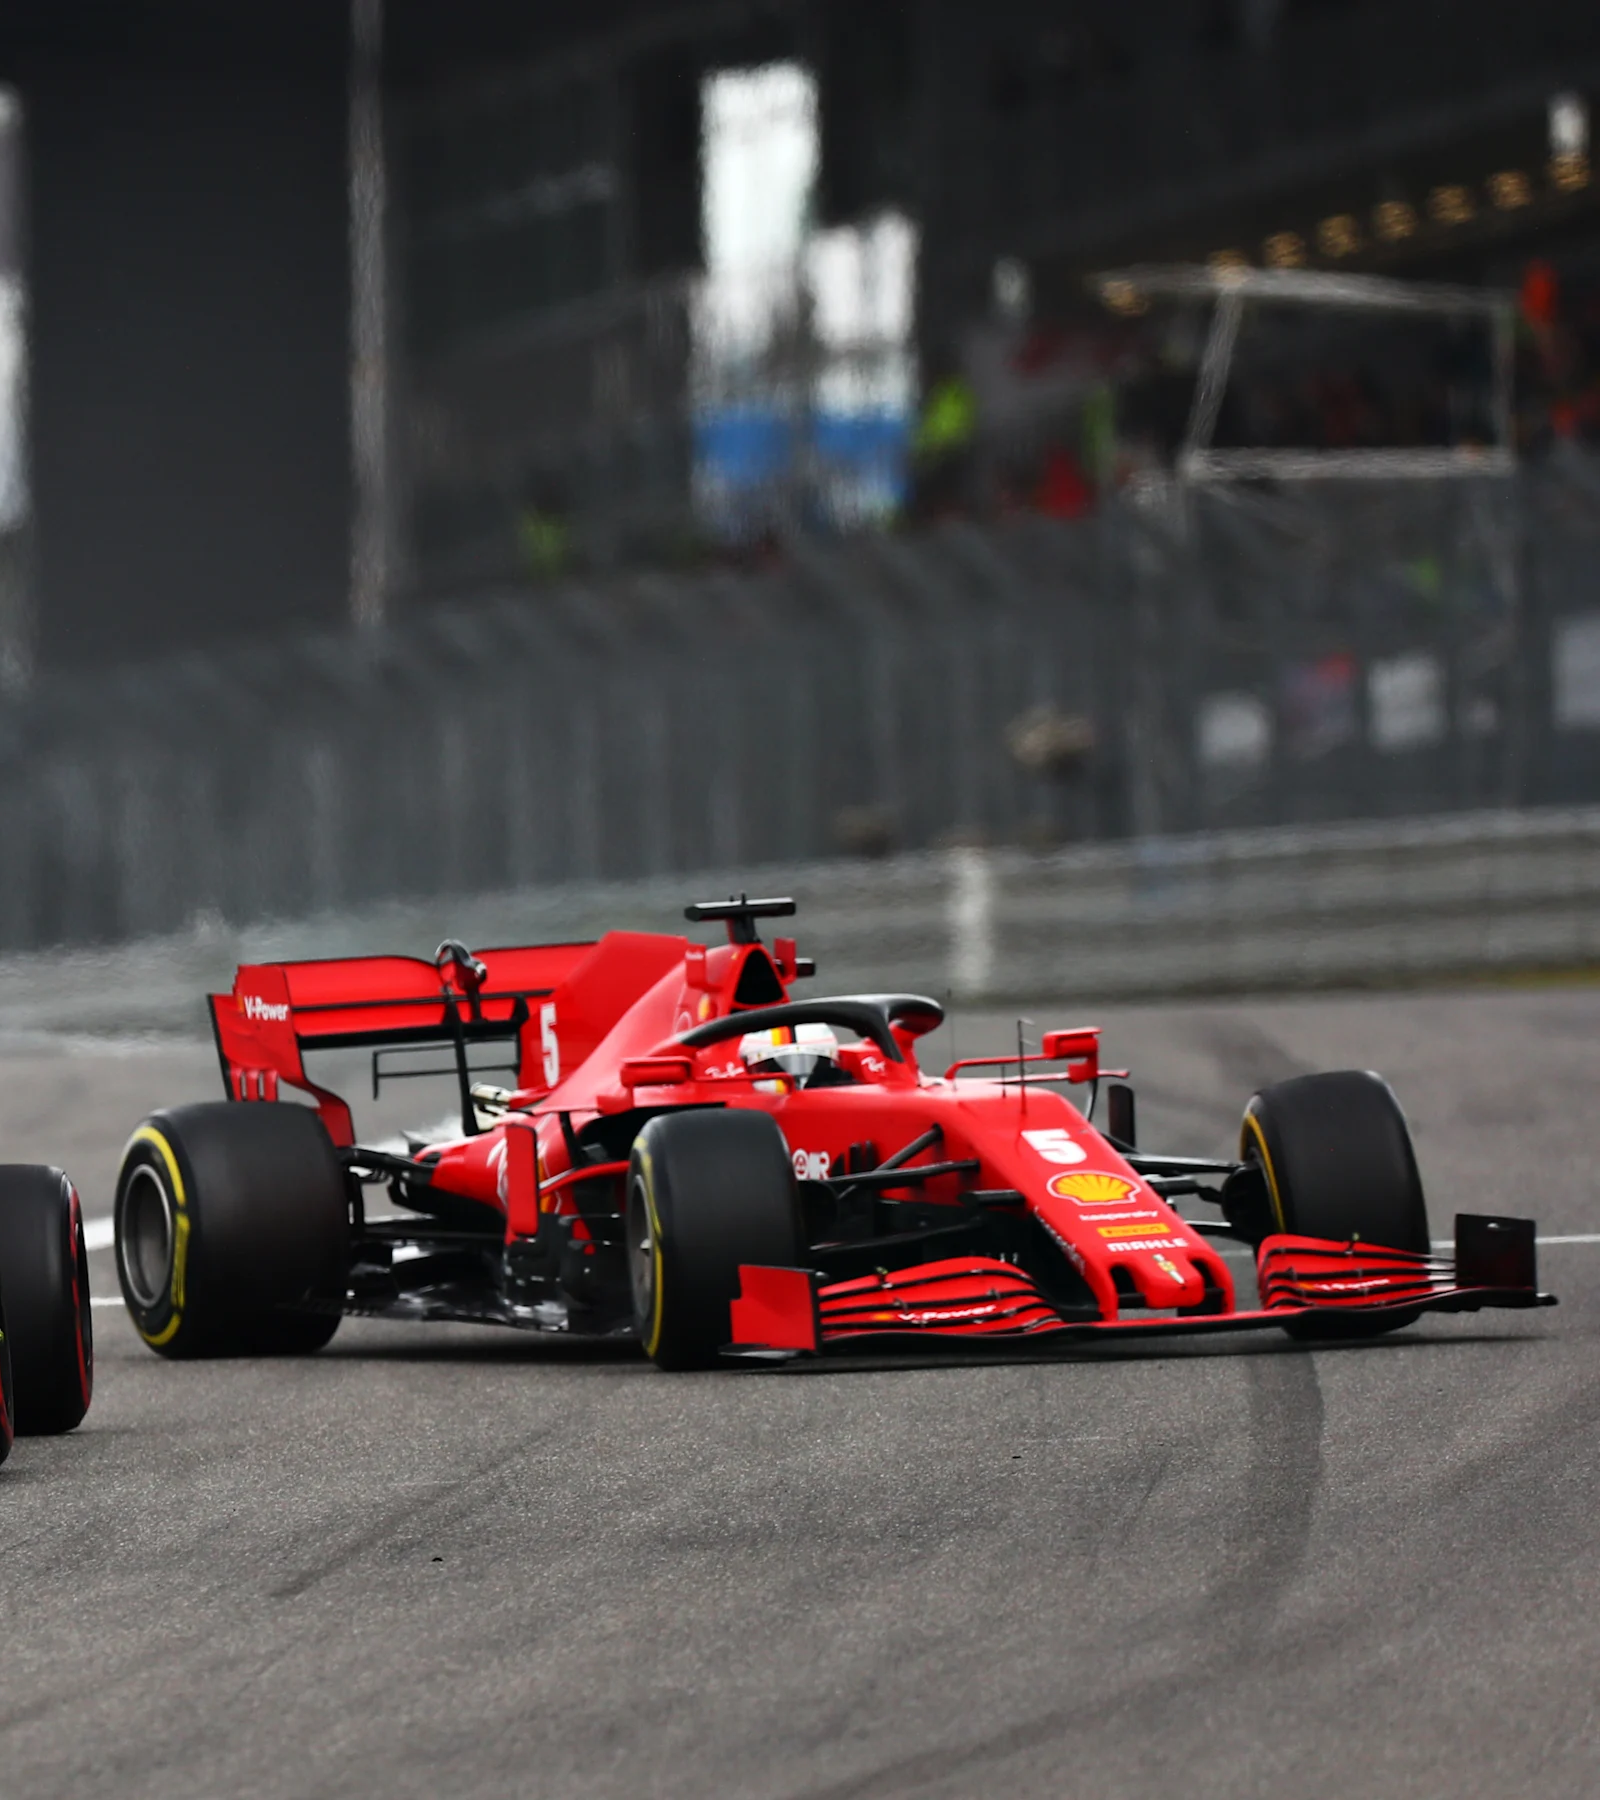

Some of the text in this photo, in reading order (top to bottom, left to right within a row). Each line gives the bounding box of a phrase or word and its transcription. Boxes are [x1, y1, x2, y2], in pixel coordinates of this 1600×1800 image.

[244, 995, 288, 1021] V-Power
[541, 1002, 560, 1089] 5
[1021, 1128, 1088, 1165] 5
